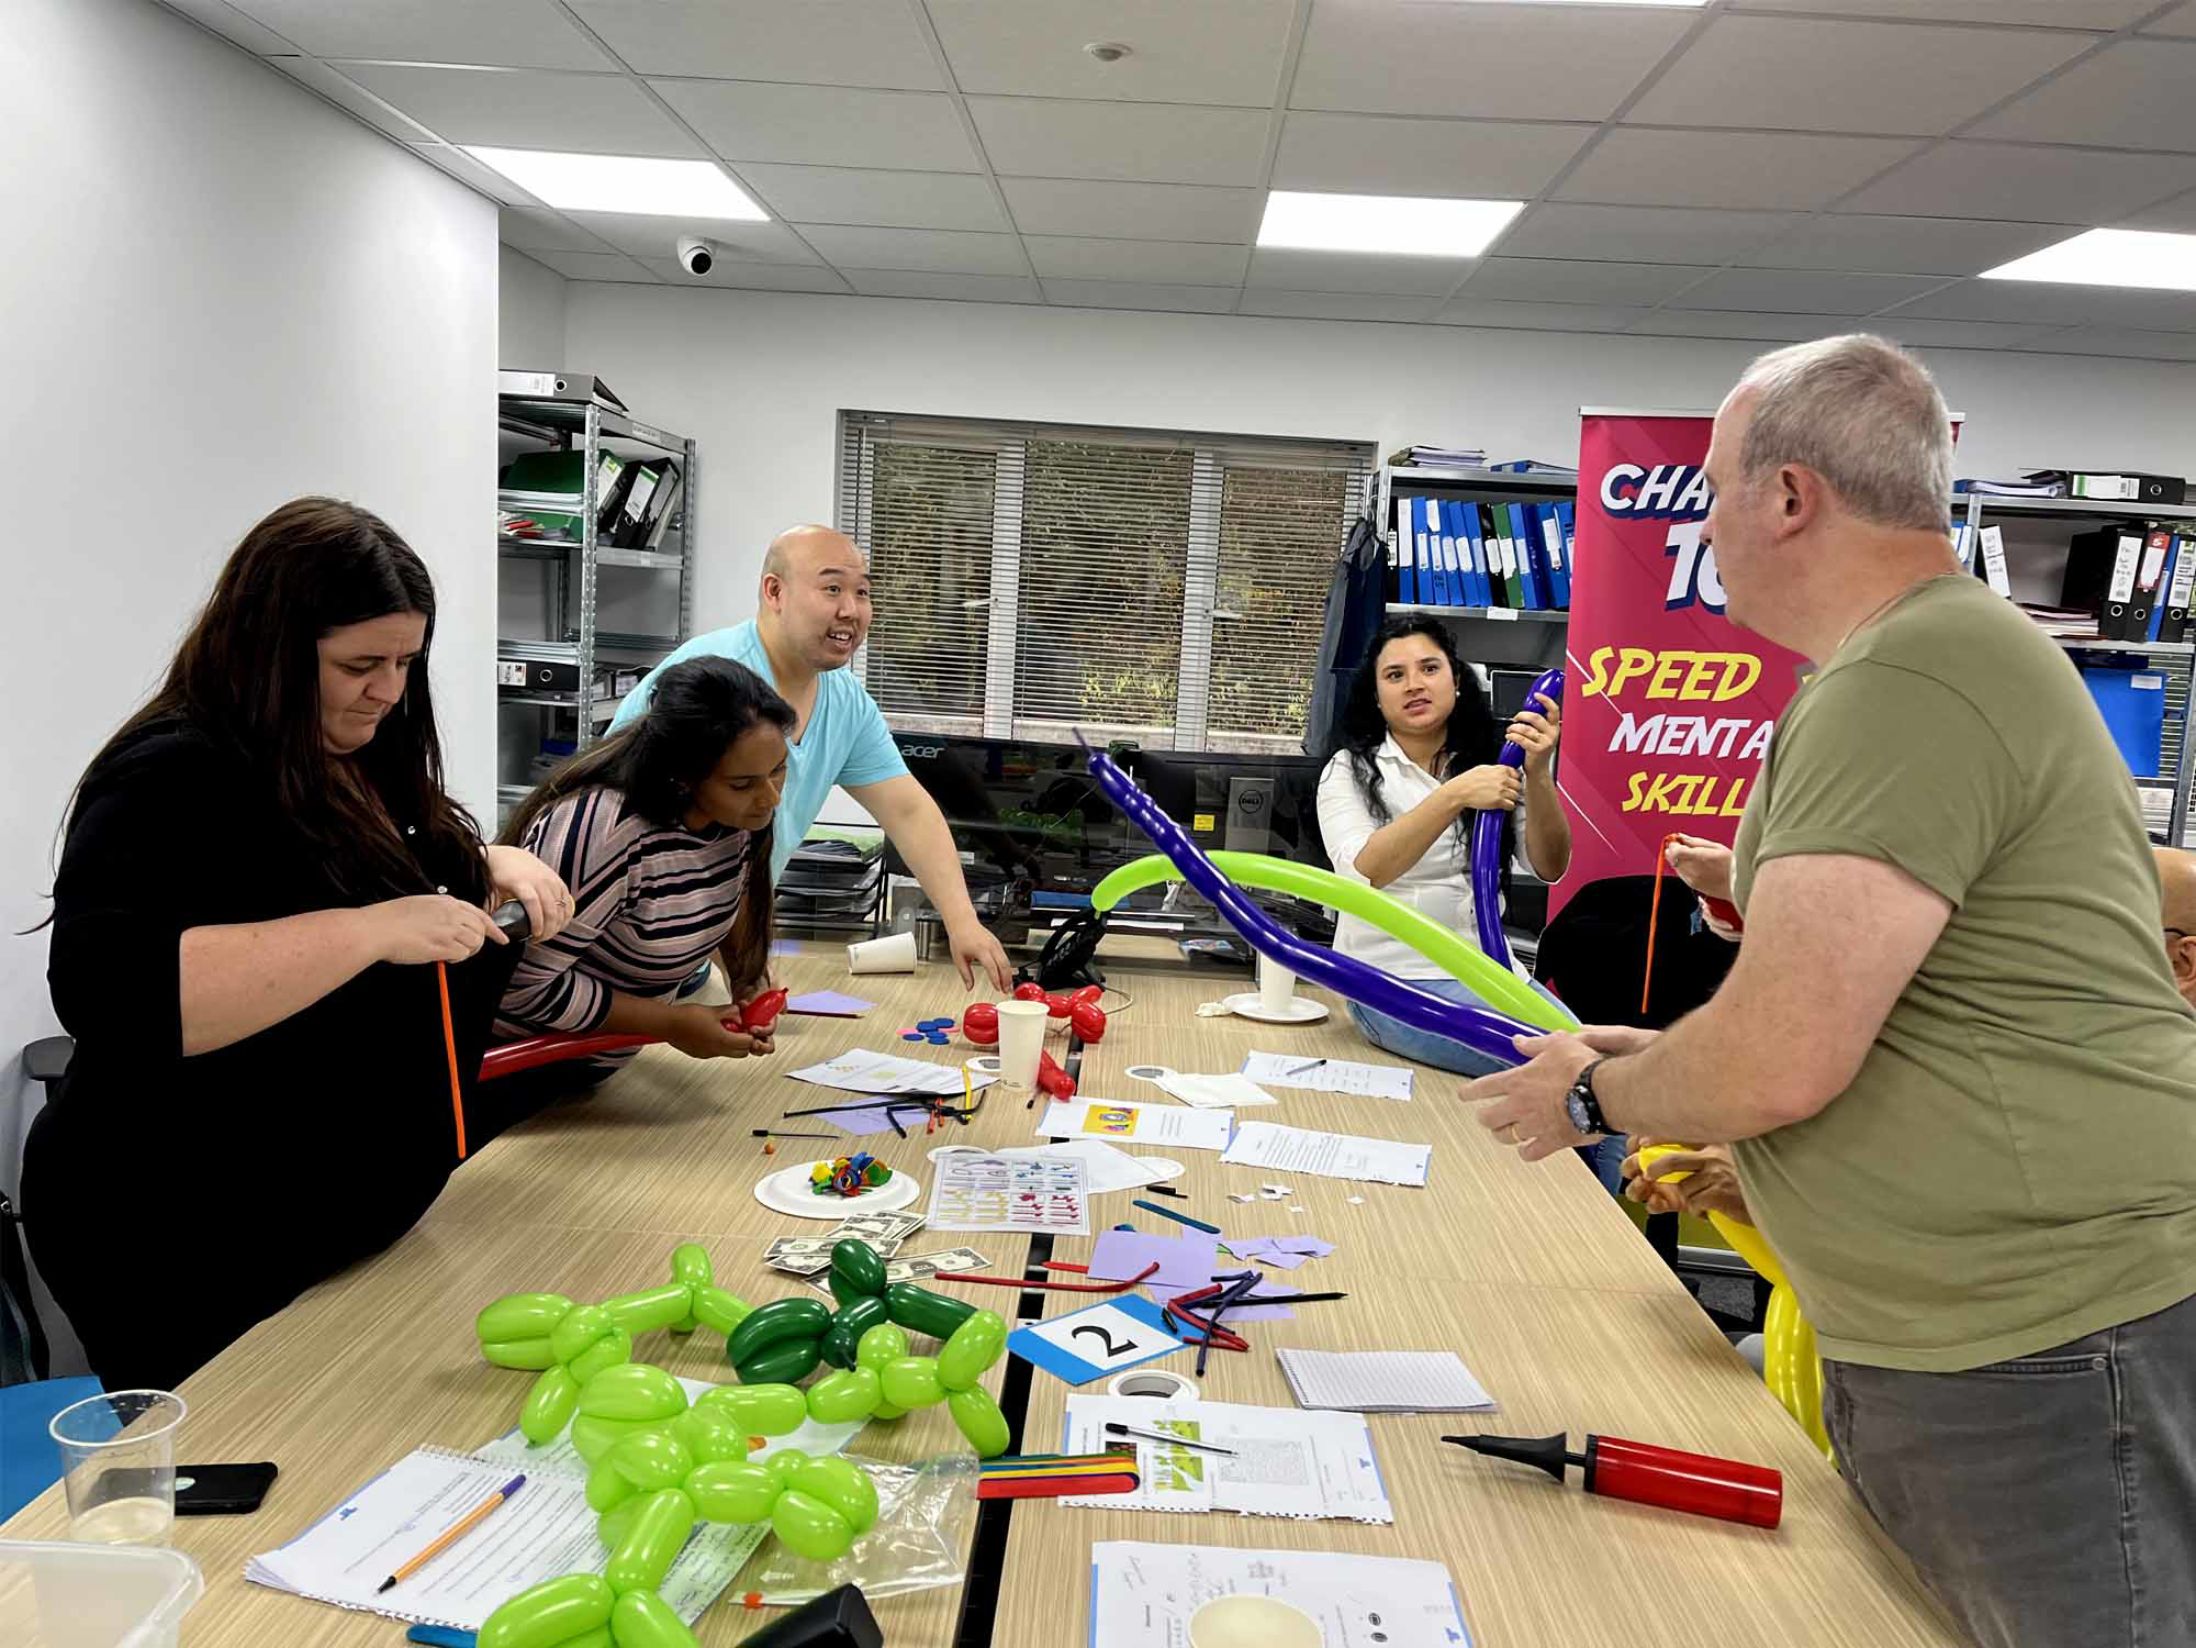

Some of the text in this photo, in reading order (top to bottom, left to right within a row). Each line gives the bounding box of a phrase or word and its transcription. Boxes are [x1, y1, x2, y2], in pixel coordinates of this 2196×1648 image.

[1601, 464, 1717, 516] CHA
[1582, 646, 1762, 701] SPEED
[901, 744, 945, 759] acer
[1071, 1325, 1139, 1358] 2
